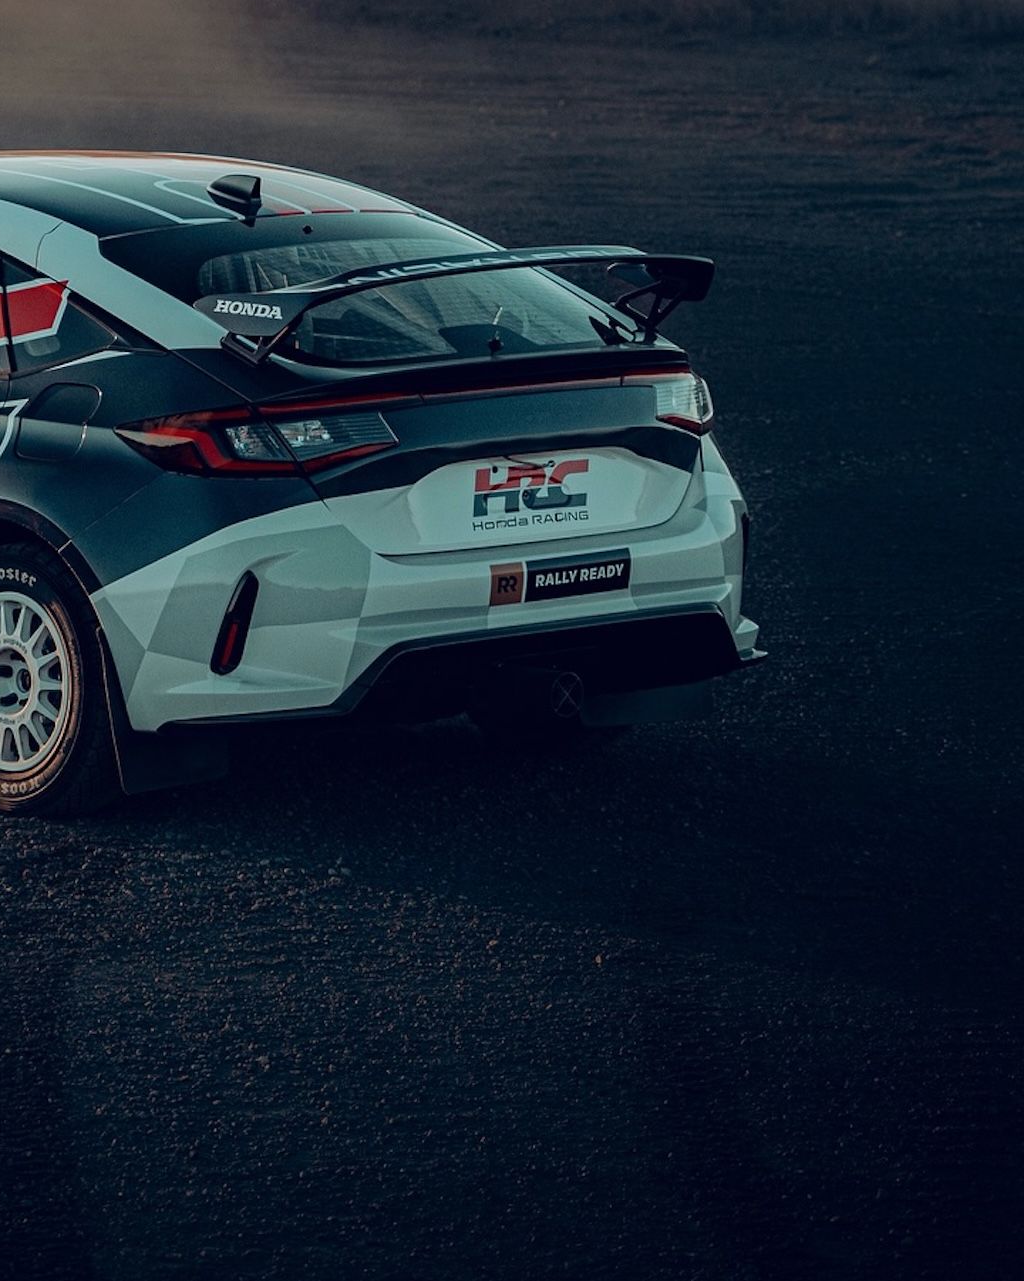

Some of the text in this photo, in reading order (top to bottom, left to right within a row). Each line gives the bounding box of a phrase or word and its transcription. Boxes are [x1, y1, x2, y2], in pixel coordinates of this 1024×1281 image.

[213, 299, 283, 320] HONDA
[473, 459, 589, 517] HRC
[472, 510, 589, 531] Honda RACING
[535, 563, 624, 588] RALLY READY
